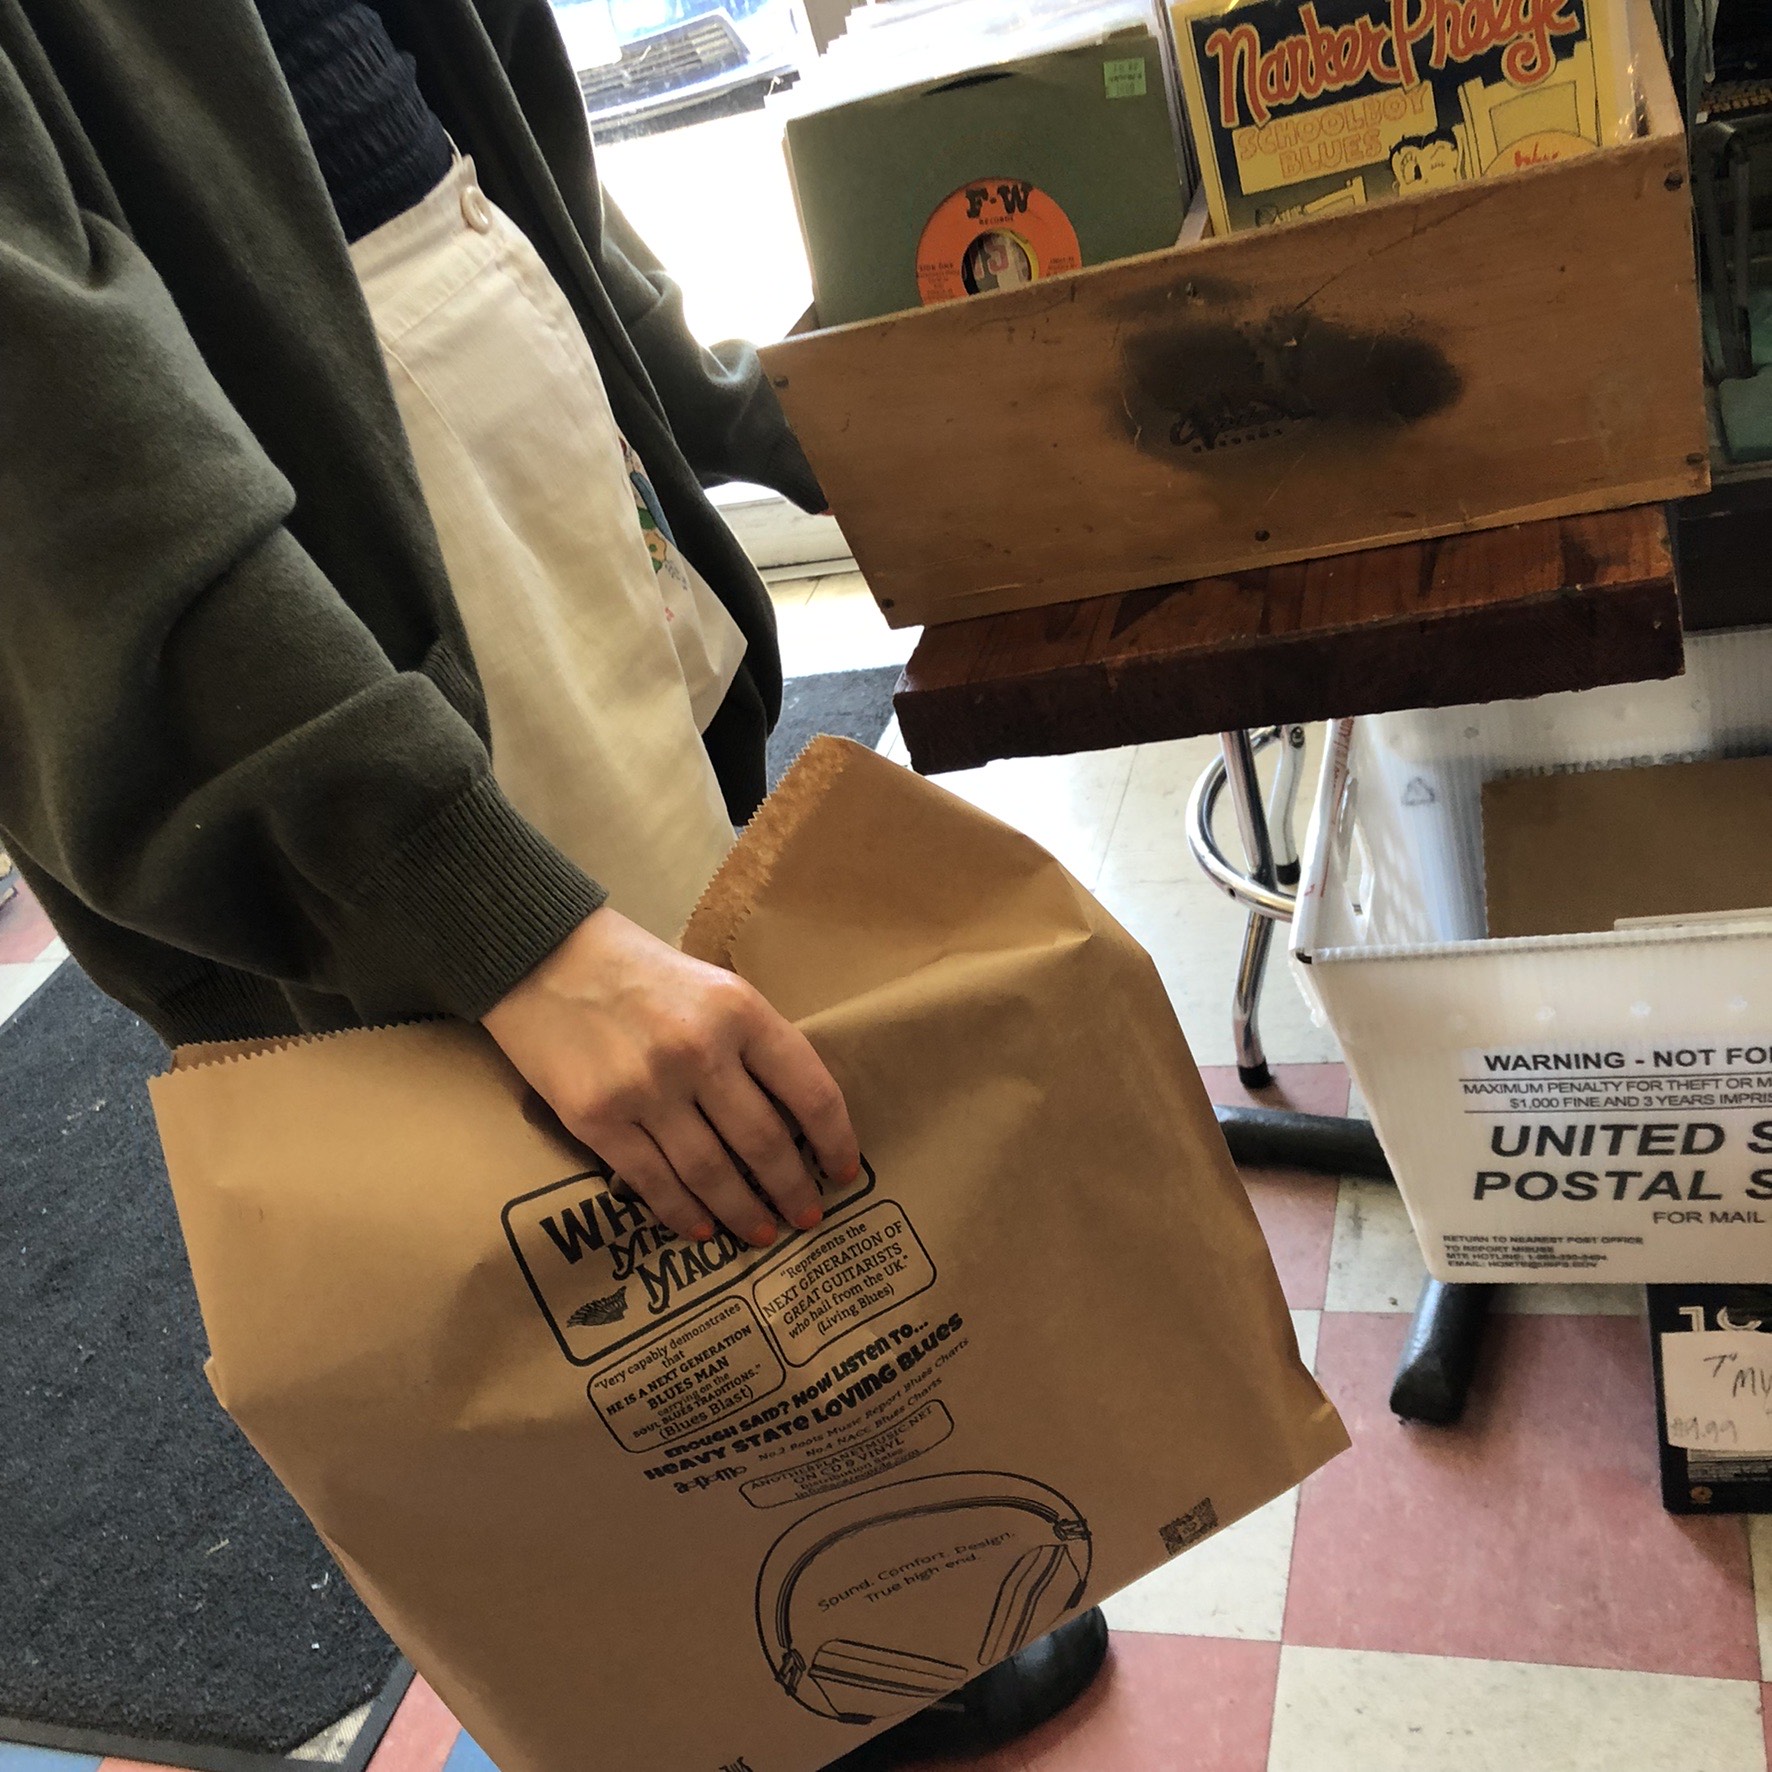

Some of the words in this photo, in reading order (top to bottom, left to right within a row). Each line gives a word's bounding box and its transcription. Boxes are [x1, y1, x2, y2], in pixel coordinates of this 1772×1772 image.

[1237, 86, 1427, 160] SCHOOLBOY
[1279, 130, 1383, 179] BLUES
[1484, 1051, 1626, 1072] WARNING
[1653, 1049, 1716, 1068] NOT
[1726, 1046, 1772, 1066] FO
[1463, 1082, 1544, 1095] MAXIMUM
[1547, 1080, 1622, 1094] PENALTY
[1626, 1080, 1663, 1092] FOR
[1666, 1078, 1723, 1091] THEFT
[1726, 1077, 1754, 1090] OR
[1509, 1097, 1560, 1110] $1,000
[1563, 1096, 1600, 1109] FINE
[1600, 1095, 1640, 1108] AND
[1643, 1095, 1653, 1107] 3
[1654, 1093, 1715, 1107] YEARS
[1490, 1122, 1726, 1157] UNITED
[1472, 1170, 1723, 1201] POSTAL
[539, 1191, 648, 1265] WH
[846, 1222, 867, 1239] the
[1492, 1235, 1506, 1243] TO
[1652, 1210, 1703, 1225] FOR
[1709, 1210, 1765, 1224] MAIL
[762, 1285, 799, 1319] NEXT
[799, 1232, 883, 1290] GENERATION
[883, 1220, 902, 1239] OF
[783, 1288, 824, 1325] GREAT
[822, 1242, 903, 1293] GUITARISTS
[789, 1316, 811, 1340] who
[811, 1299, 832, 1321] hail
[833, 1284, 864, 1308] from
[863, 1271, 884, 1288] the
[817, 1303, 860, 1336] (Living
[859, 1283, 895, 1309] Blues)
[627, 1346, 668, 1375] capably
[669, 1303, 742, 1349] demonstrates
[662, 1350, 685, 1368] that
[605, 1401, 624, 1416] HE
[623, 1393, 637, 1406] IS
[638, 1387, 649, 1399] A
[647, 1367, 679, 1394] NEXT
[680, 1325, 752, 1373] GENERATION
[647, 1379, 694, 1410] BLUES
[694, 1356, 730, 1384] MAN
[700, 1383, 712, 1395] on
[713, 1372, 730, 1388] the
[827, 1417, 862, 1438] Music
[865, 1389, 901, 1420] Report
[903, 1367, 932, 1392] Blues
[934, 1338, 970, 1369] Charts
[632, 1420, 662, 1438] SOUL
[662, 1404, 694, 1425] BLUES
[659, 1409, 708, 1440] (Blues
[708, 1384, 753, 1416] Blast)
[874, 1405, 905, 1428] Blues
[907, 1376, 943, 1406] Charts
[859, 1439, 905, 1462] VINYL
[817, 1578, 875, 1612] Sound.
[954, 1530, 1016, 1555] Design.
[863, 1581, 902, 1604] True
[904, 1565, 940, 1586] high
